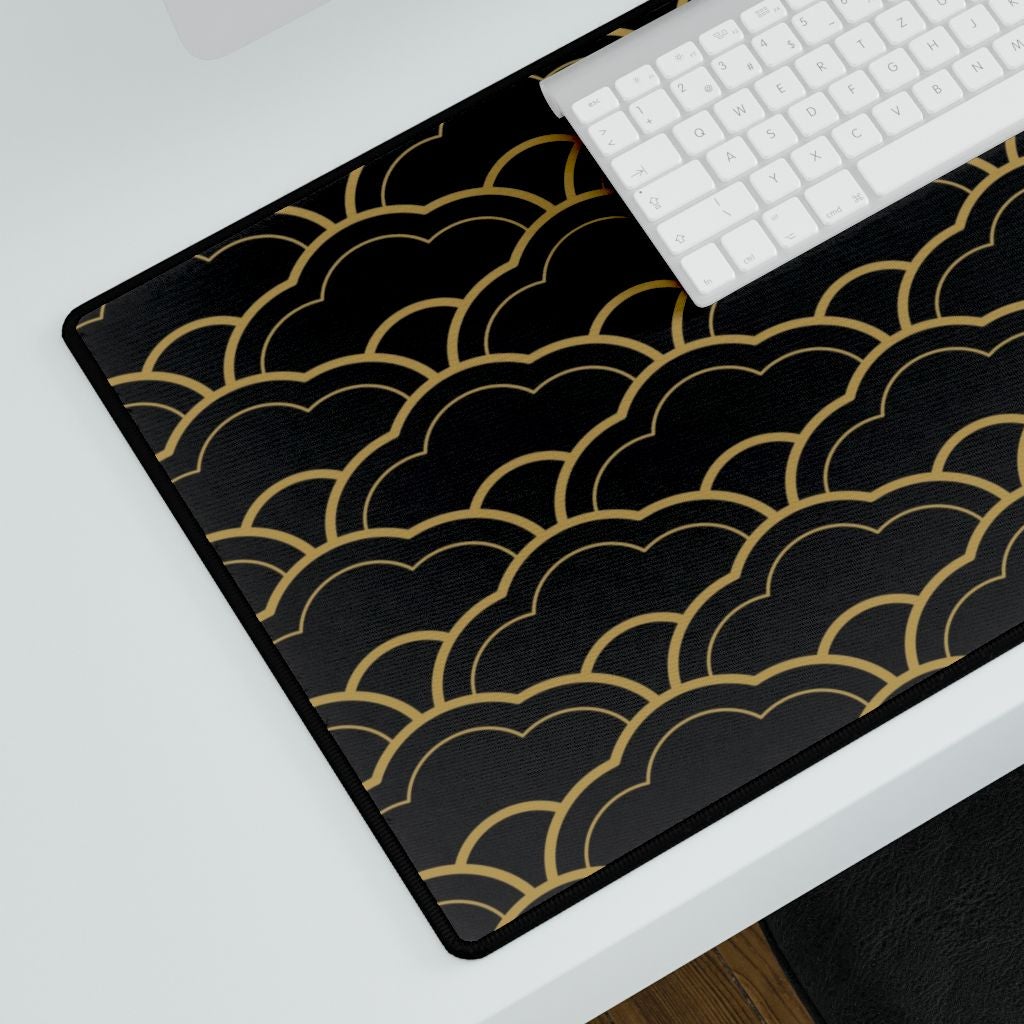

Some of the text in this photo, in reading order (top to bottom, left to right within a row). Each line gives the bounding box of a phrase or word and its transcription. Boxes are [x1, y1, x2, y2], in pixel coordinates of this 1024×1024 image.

[799, 16, 808, 27] 5
[897, 17, 908, 28] Z
[970, 18, 977, 29] J
[760, 39, 768, 47] 4
[856, 39, 865, 49] T
[926, 39, 939, 51] H
[1011, 39, 1024, 52] M
[718, 61, 727, 71] 3
[816, 61, 826, 72] R
[887, 62, 898, 72] G
[971, 61, 984, 73] N
[677, 83, 687, 93] 2
[776, 83, 786, 94] E
[847, 84, 855, 95] F
[931, 84, 943, 95] B
[635, 105, 644, 114] 1
[732, 104, 746, 117] W
[805, 106, 817, 118] D
[890, 105, 901, 116] V
[694, 128, 706, 138] Q
[766, 129, 776, 139] S
[851, 128, 862, 139] C
[726, 151, 737, 163] A
[809, 150, 822, 162] X
[768, 172, 778, 183] Y
[825, 206, 843, 218] cmd
